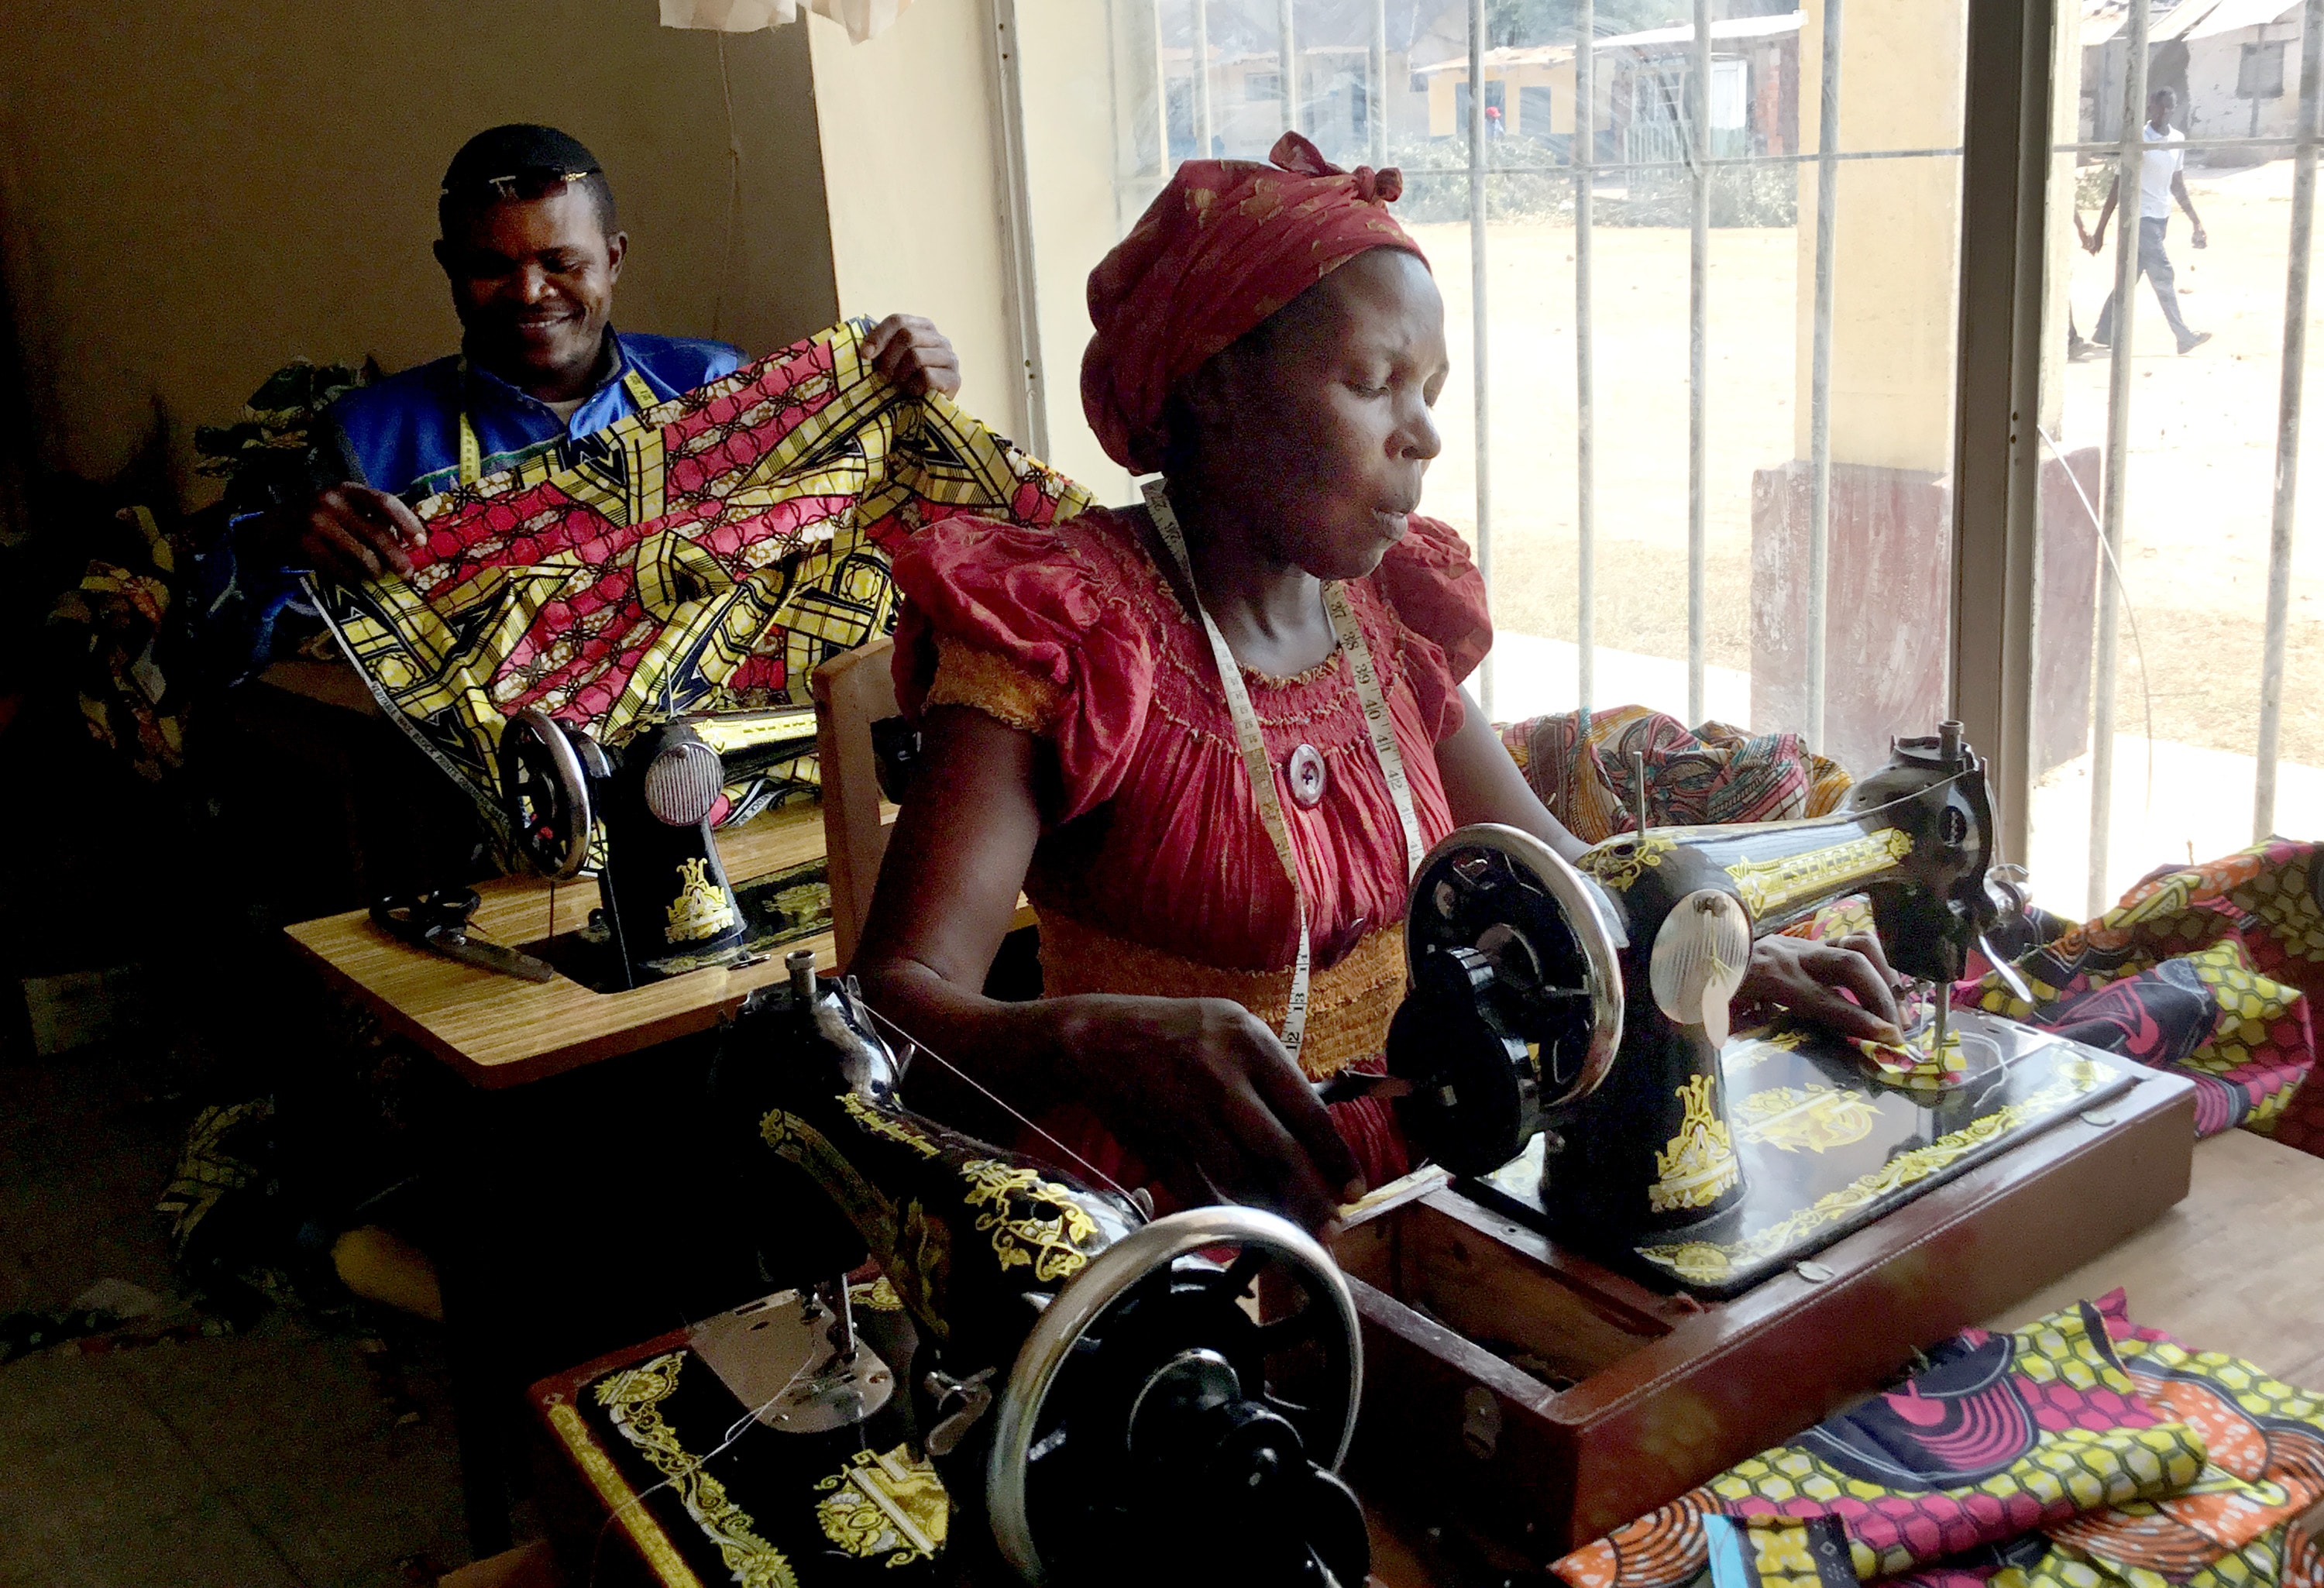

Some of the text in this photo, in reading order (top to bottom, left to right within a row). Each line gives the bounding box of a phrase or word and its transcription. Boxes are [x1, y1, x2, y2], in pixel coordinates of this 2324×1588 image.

[749, 717, 814, 738] SINGE
[1330, 600, 1347, 619] 37
[1342, 631, 1360, 651] 38
[1356, 663, 1371, 685] 39
[1366, 699, 1381, 720] 40
[1376, 734, 1391, 754] 41
[1387, 769, 1403, 791] 42
[1401, 804, 1414, 826] 43
[1409, 840, 1422, 862] 44
[1789, 841, 1875, 885] SINGER
[1285, 1031, 1300, 1053] 12
[1293, 992, 1305, 1012] 13
